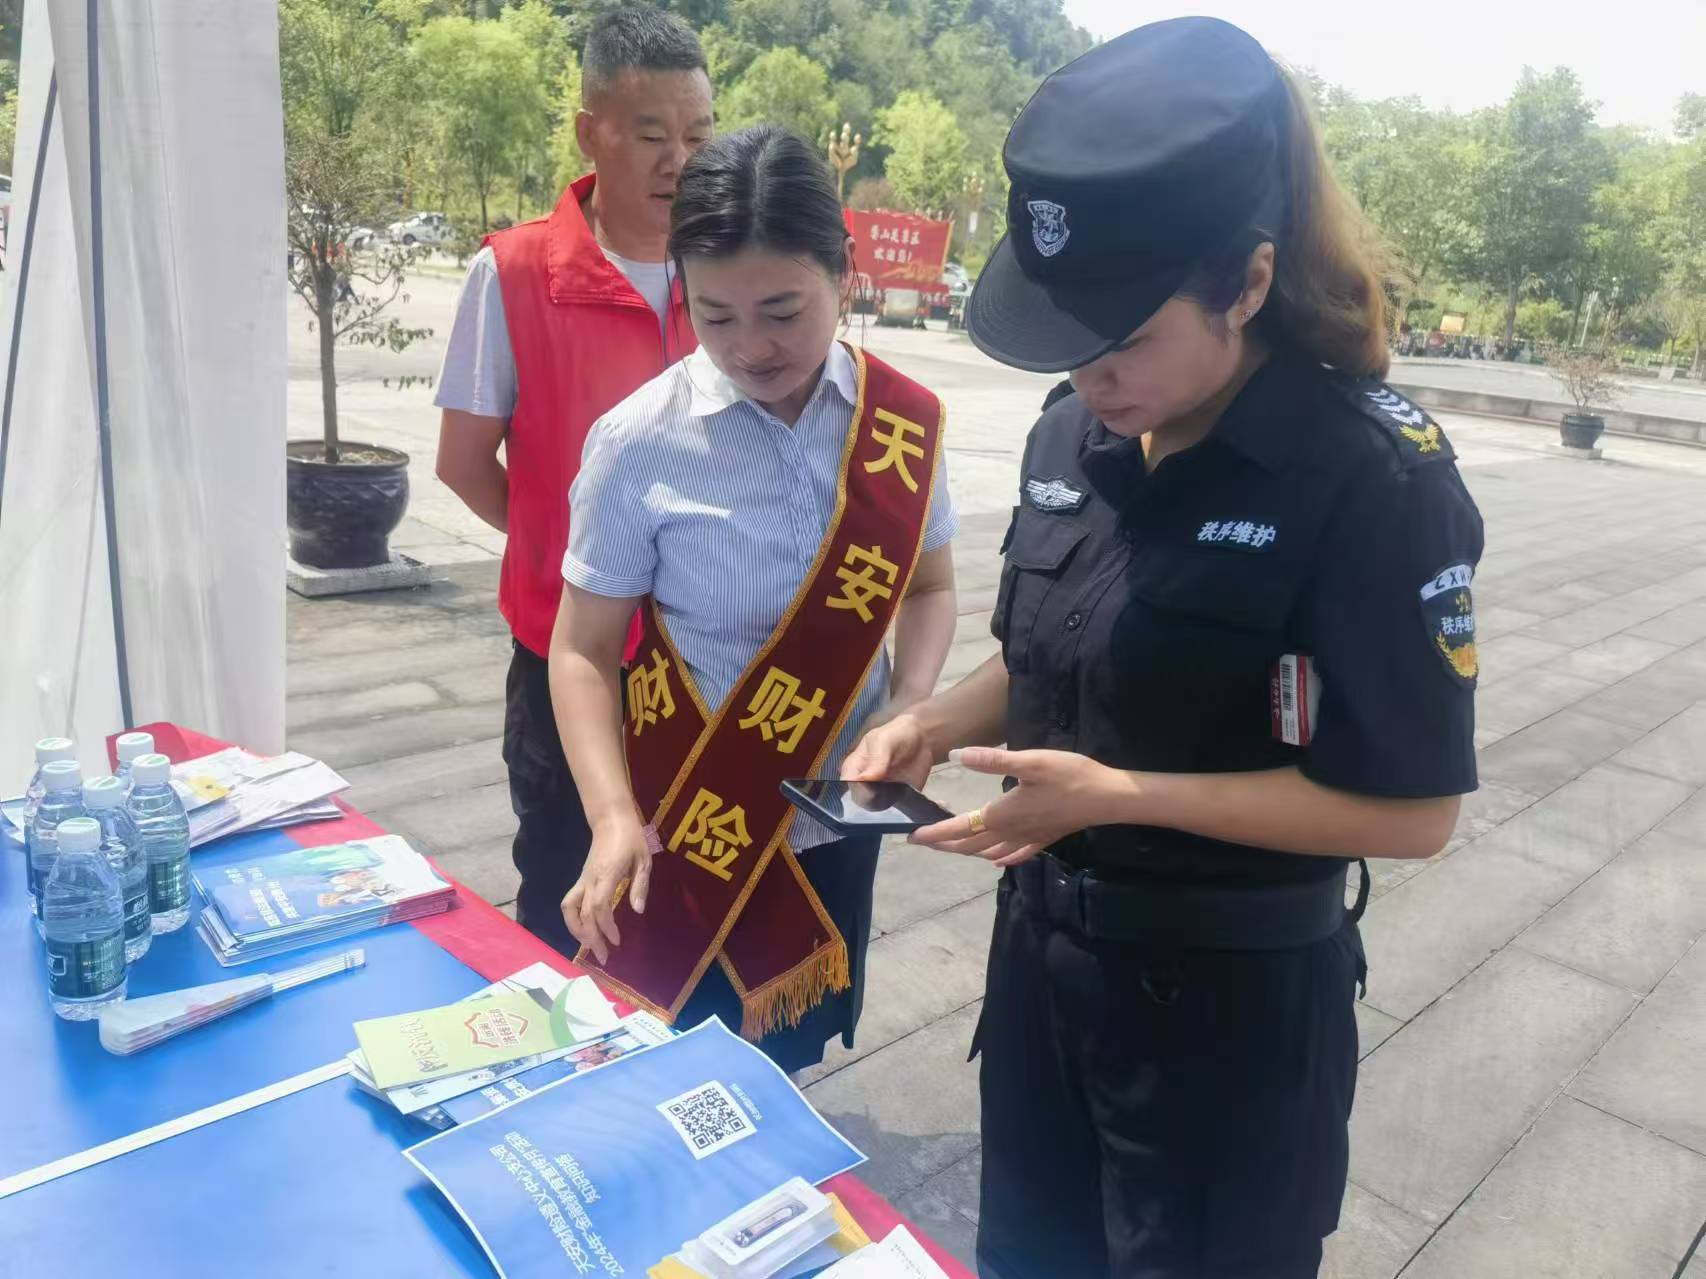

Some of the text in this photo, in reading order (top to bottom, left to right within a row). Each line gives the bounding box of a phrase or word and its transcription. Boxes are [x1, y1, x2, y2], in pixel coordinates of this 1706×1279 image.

[1197, 520, 1277, 547] 秩序维护
[668, 406, 927, 884] 天安财险
[1440, 614, 1474, 636] 秩序维
[625, 647, 678, 738] 财
[489, 1143, 598, 1276] 天安财险遵义中心支公司
[554, 1151, 602, 1205] 知识问答
